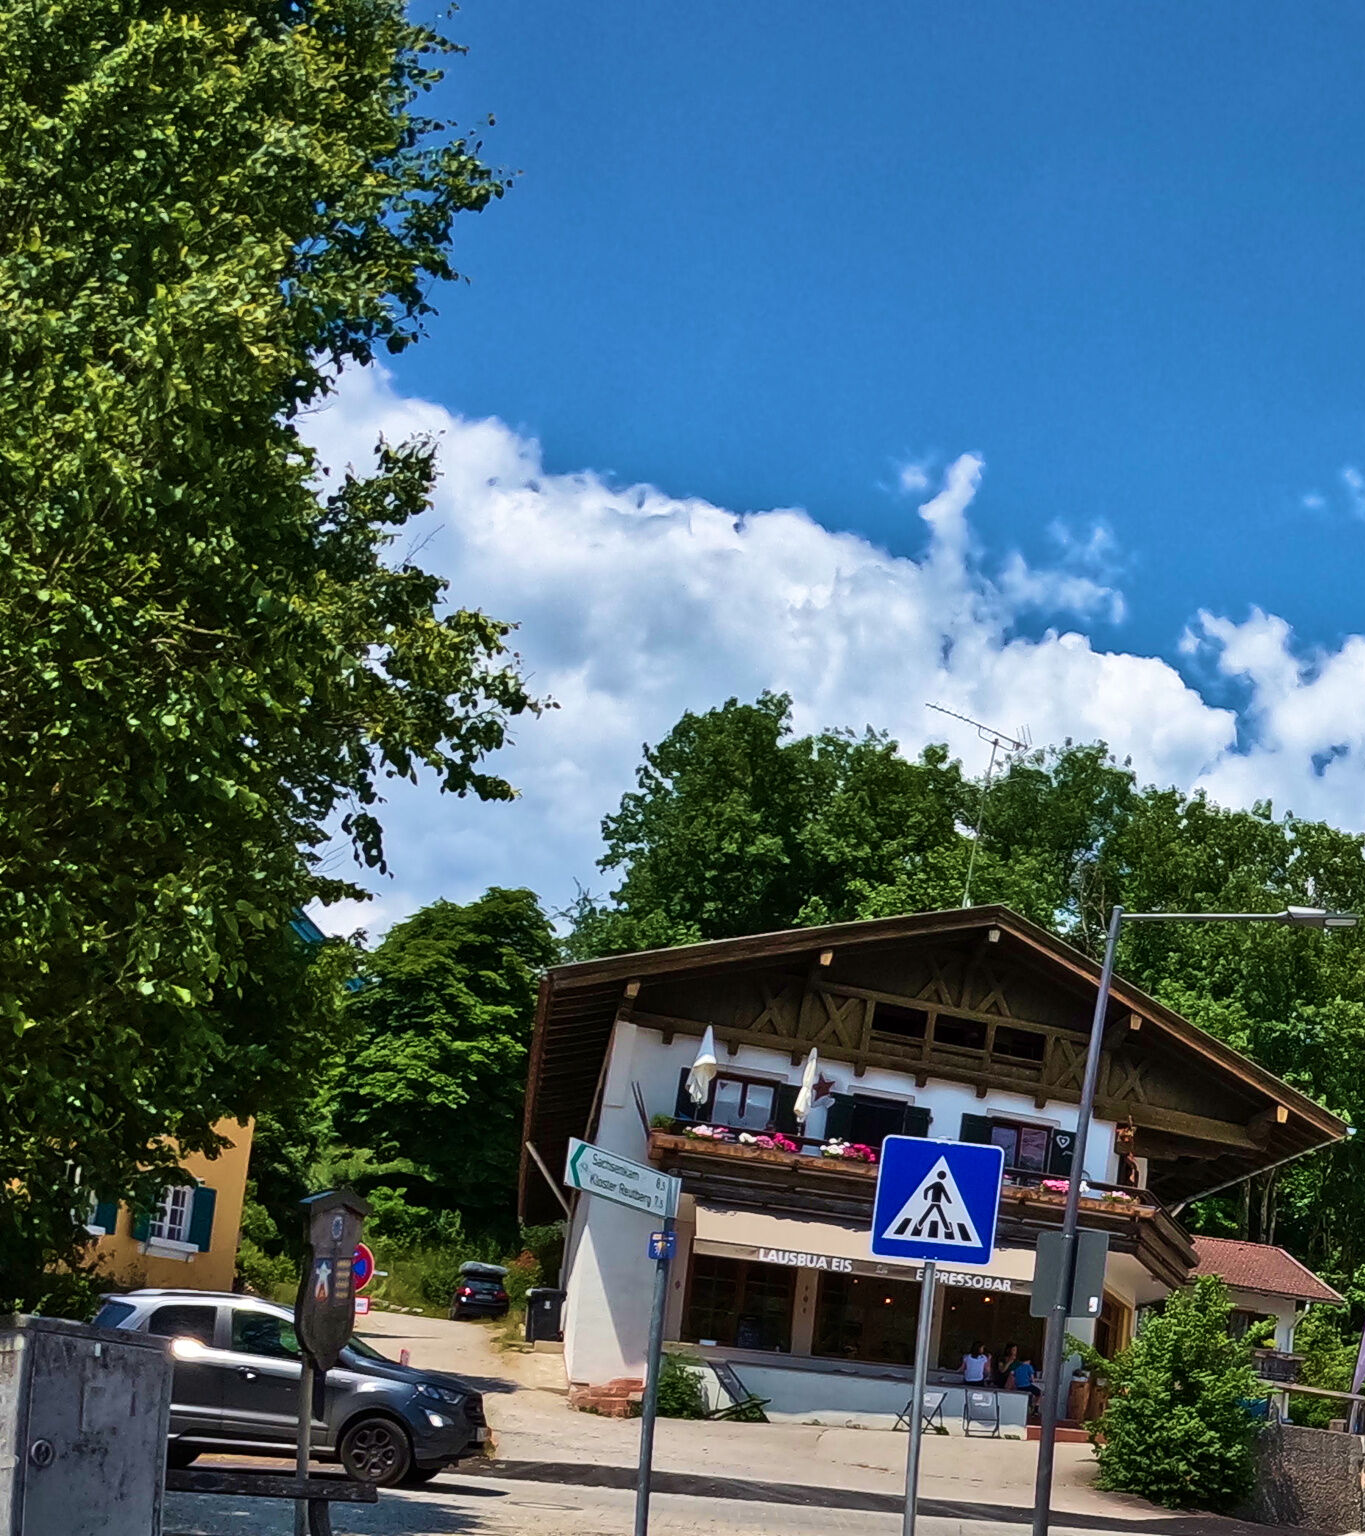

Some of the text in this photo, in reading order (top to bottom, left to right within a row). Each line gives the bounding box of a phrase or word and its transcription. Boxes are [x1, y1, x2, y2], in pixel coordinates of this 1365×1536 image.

[590, 1173, 617, 1191] Kloster
[759, 1247, 852, 1273] LAUSBUA EIS
[915, 1268, 1012, 1292] EPRESSOBAR
